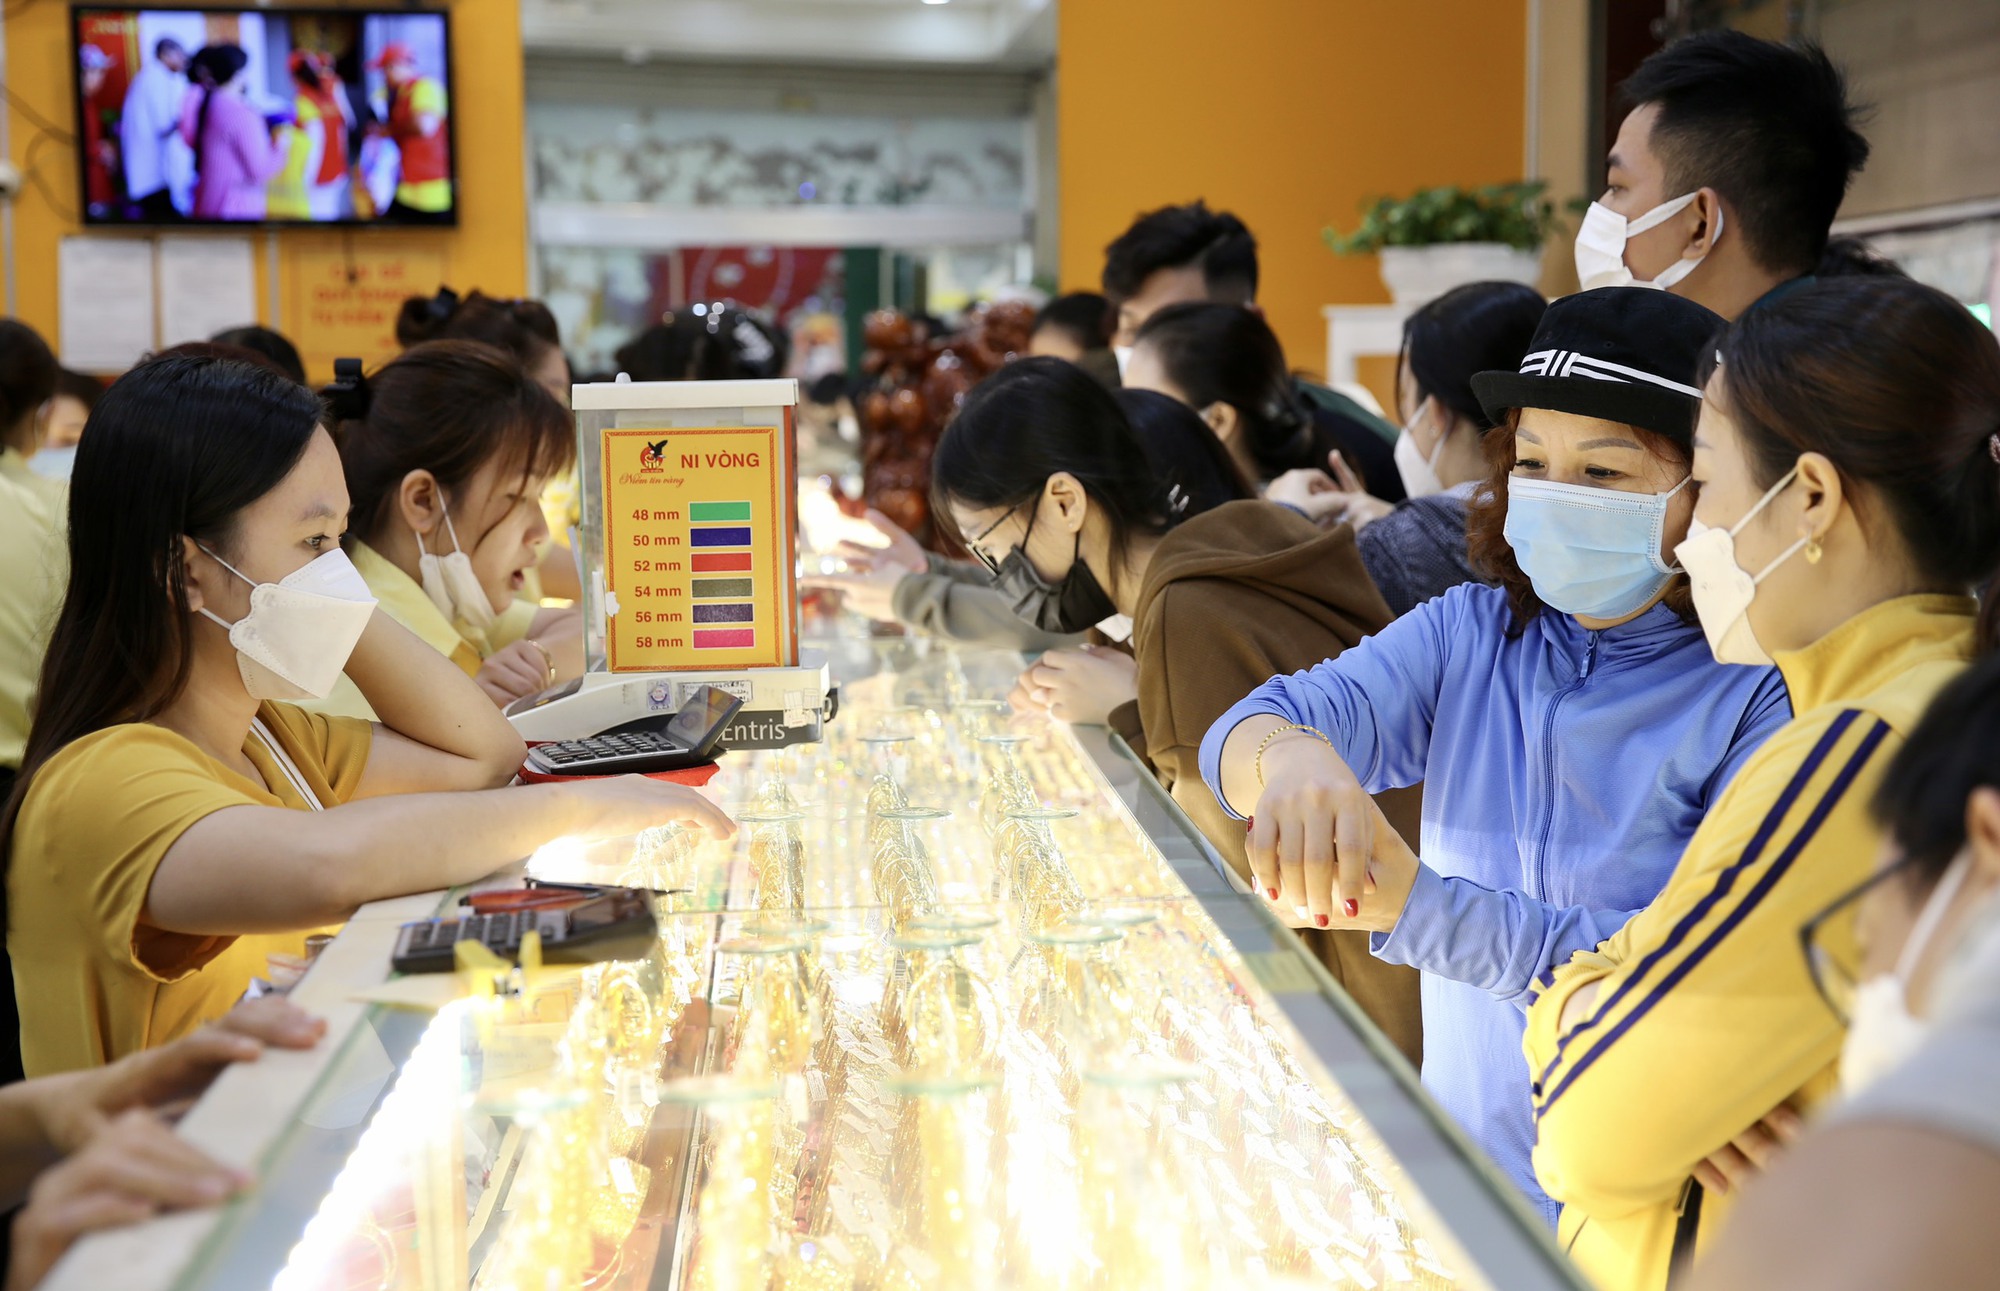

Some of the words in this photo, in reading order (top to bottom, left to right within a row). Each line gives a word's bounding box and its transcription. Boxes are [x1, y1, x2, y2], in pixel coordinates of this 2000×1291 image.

[681, 454, 699, 468] NI
[705, 450, 760, 468] VÒNG
[632, 509, 649, 521] 48
[653, 511, 680, 520] mm
[633, 534, 650, 546] 50
[654, 536, 680, 546] mm
[634, 560, 650, 572] 52
[655, 562, 681, 571] mm
[635, 586, 651, 597] 54
[656, 587, 682, 597] mm
[635, 611, 652, 623] 56
[656, 613, 682, 622] mm
[636, 636, 653, 648] 58
[657, 638, 683, 647] mm
